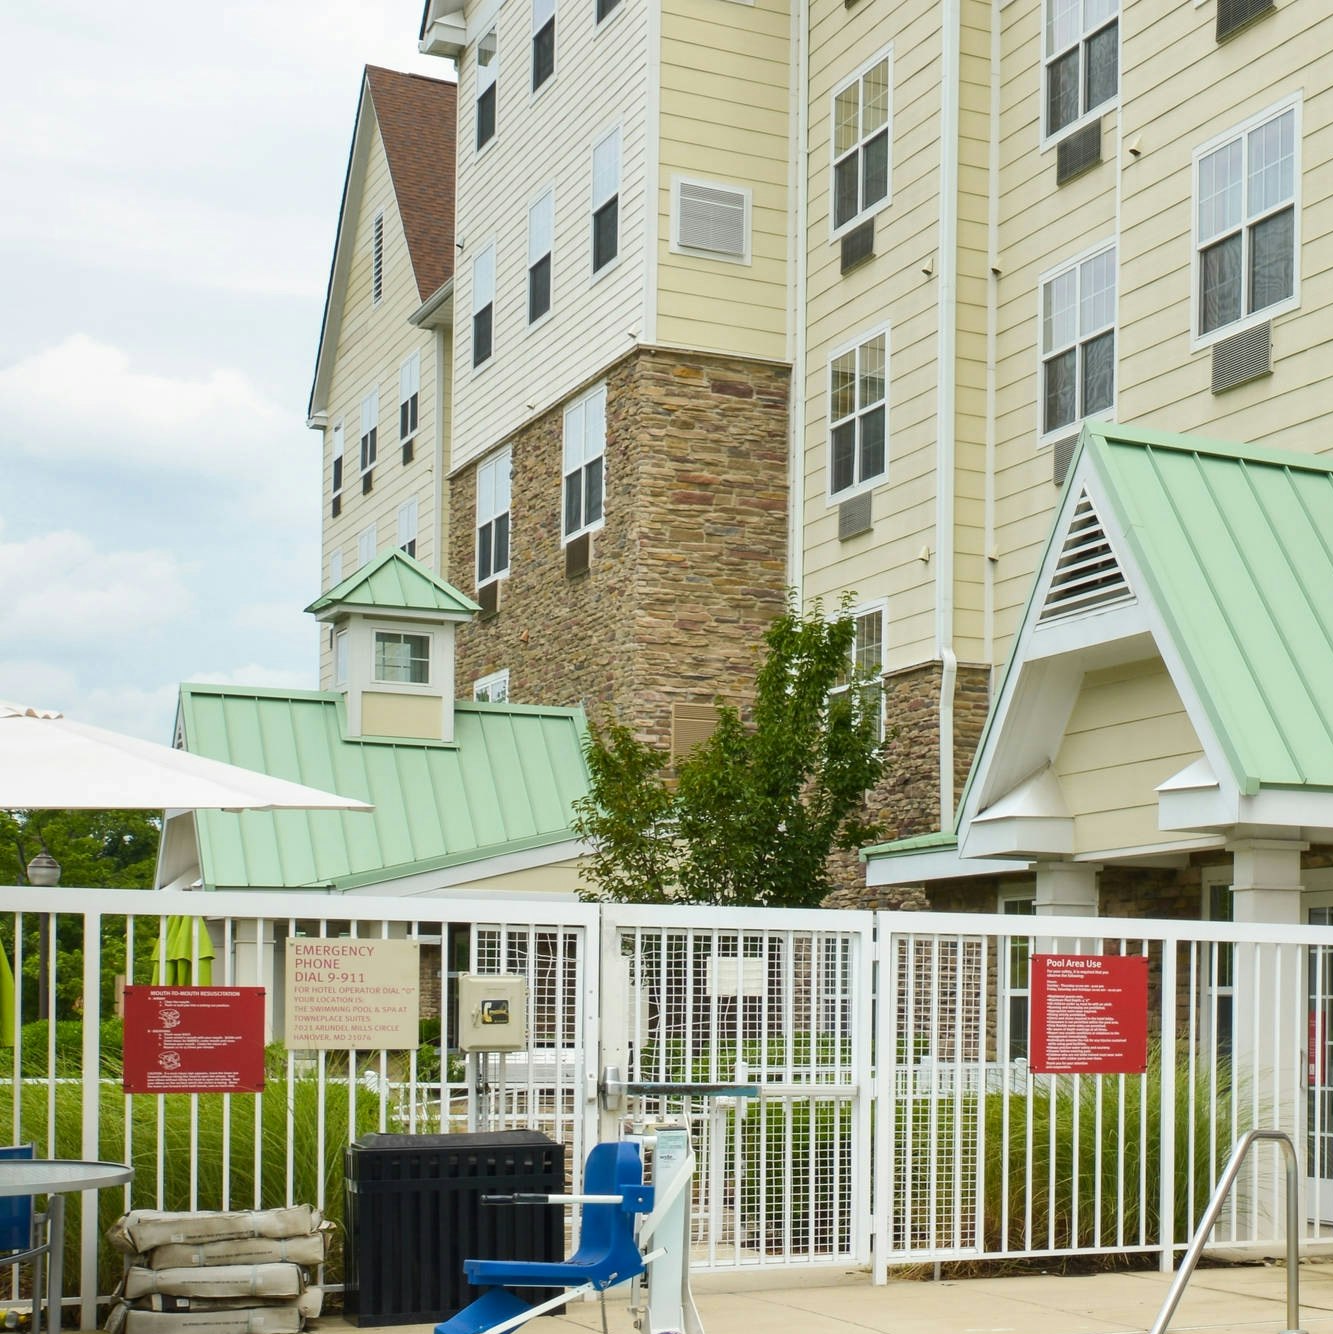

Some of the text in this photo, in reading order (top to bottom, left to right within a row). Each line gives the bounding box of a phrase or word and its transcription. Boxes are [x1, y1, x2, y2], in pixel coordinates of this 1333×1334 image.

[295, 945, 374, 957] EMERGENCY
[295, 958, 340, 969] PHONE
[1046, 958, 1102, 968] Pool Area Use
[295, 972, 365, 983] DIAL 9-911
[294, 986, 309, 994] FOR
[311, 986, 337, 994] HOTEL
[338, 987, 381, 995] OPERATOR
[382, 987, 400, 995] DIAL
